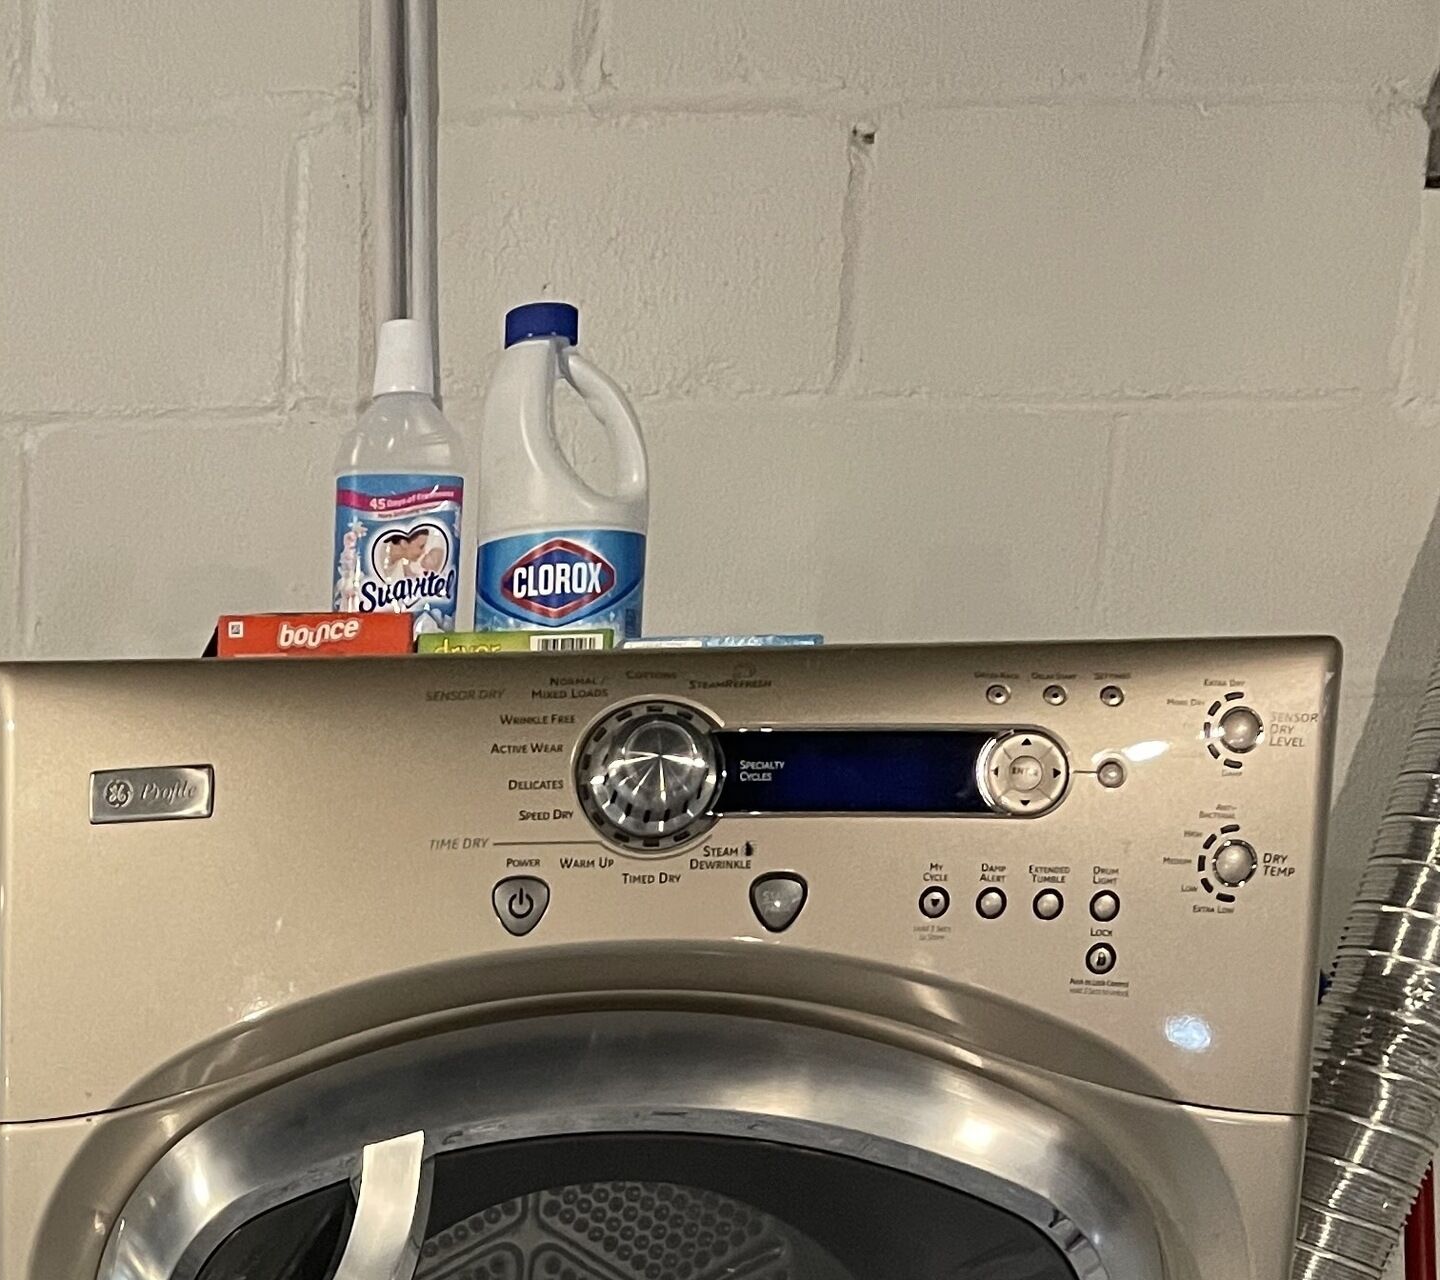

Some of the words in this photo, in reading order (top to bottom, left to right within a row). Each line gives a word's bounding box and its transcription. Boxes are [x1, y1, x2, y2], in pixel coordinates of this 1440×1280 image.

[369, 498, 386, 510] 45
[513, 562, 602, 598] CLOROX
[359, 570, 455, 613] Suavitel
[279, 619, 360, 648] bounce
[425, 689, 477, 701] SENSOR
[478, 688, 506, 699] DRY
[531, 689, 567, 699] MIXED
[571, 688, 608, 698] LOADS
[499, 714, 548, 725] WRINKLE
[551, 714, 575, 723] FREE
[1271, 712, 1319, 723] SENSOR
[1270, 723, 1295, 734] DRY
[1269, 737, 1305, 747] LEVEL
[490, 743, 528, 754] ACTIVE
[530, 742, 563, 753] WEAR
[739, 760, 785, 770] SPECIALTY
[739, 771, 772, 781] CYCLES
[508, 779, 564, 790] DELICATES
[141, 779, 198, 805] Profile
[518, 810, 550, 821] SPEED
[552, 809, 574, 820] DRY
[430, 838, 459, 850] TIME
[462, 837, 489, 849] DRY
[703, 845, 738, 857] STEAM
[506, 858, 540, 868] POWER
[560, 858, 595, 869] WARM
[598, 857, 614, 868] UP
[689, 858, 751, 870] DEWRINKLE
[1263, 853, 1288, 864] DRY
[930, 862, 943, 871] MY
[982, 863, 1006, 872] DAMP
[1028, 864, 1071, 874] EXTENDED
[1093, 865, 1119, 874] DRUM
[1263, 865, 1295, 877] TEMP
[622, 872, 655, 884] TIMED
[659, 872, 681, 884] DRY
[923, 872, 948, 882] CYCLE
[980, 873, 1006, 883] ALERT
[1032, 874, 1066, 883] TUMBLE
[1093, 876, 1118, 885] LIGHT
[1193, 904, 1215, 913] EXTRA
[1090, 928, 1113, 937] LOCK
